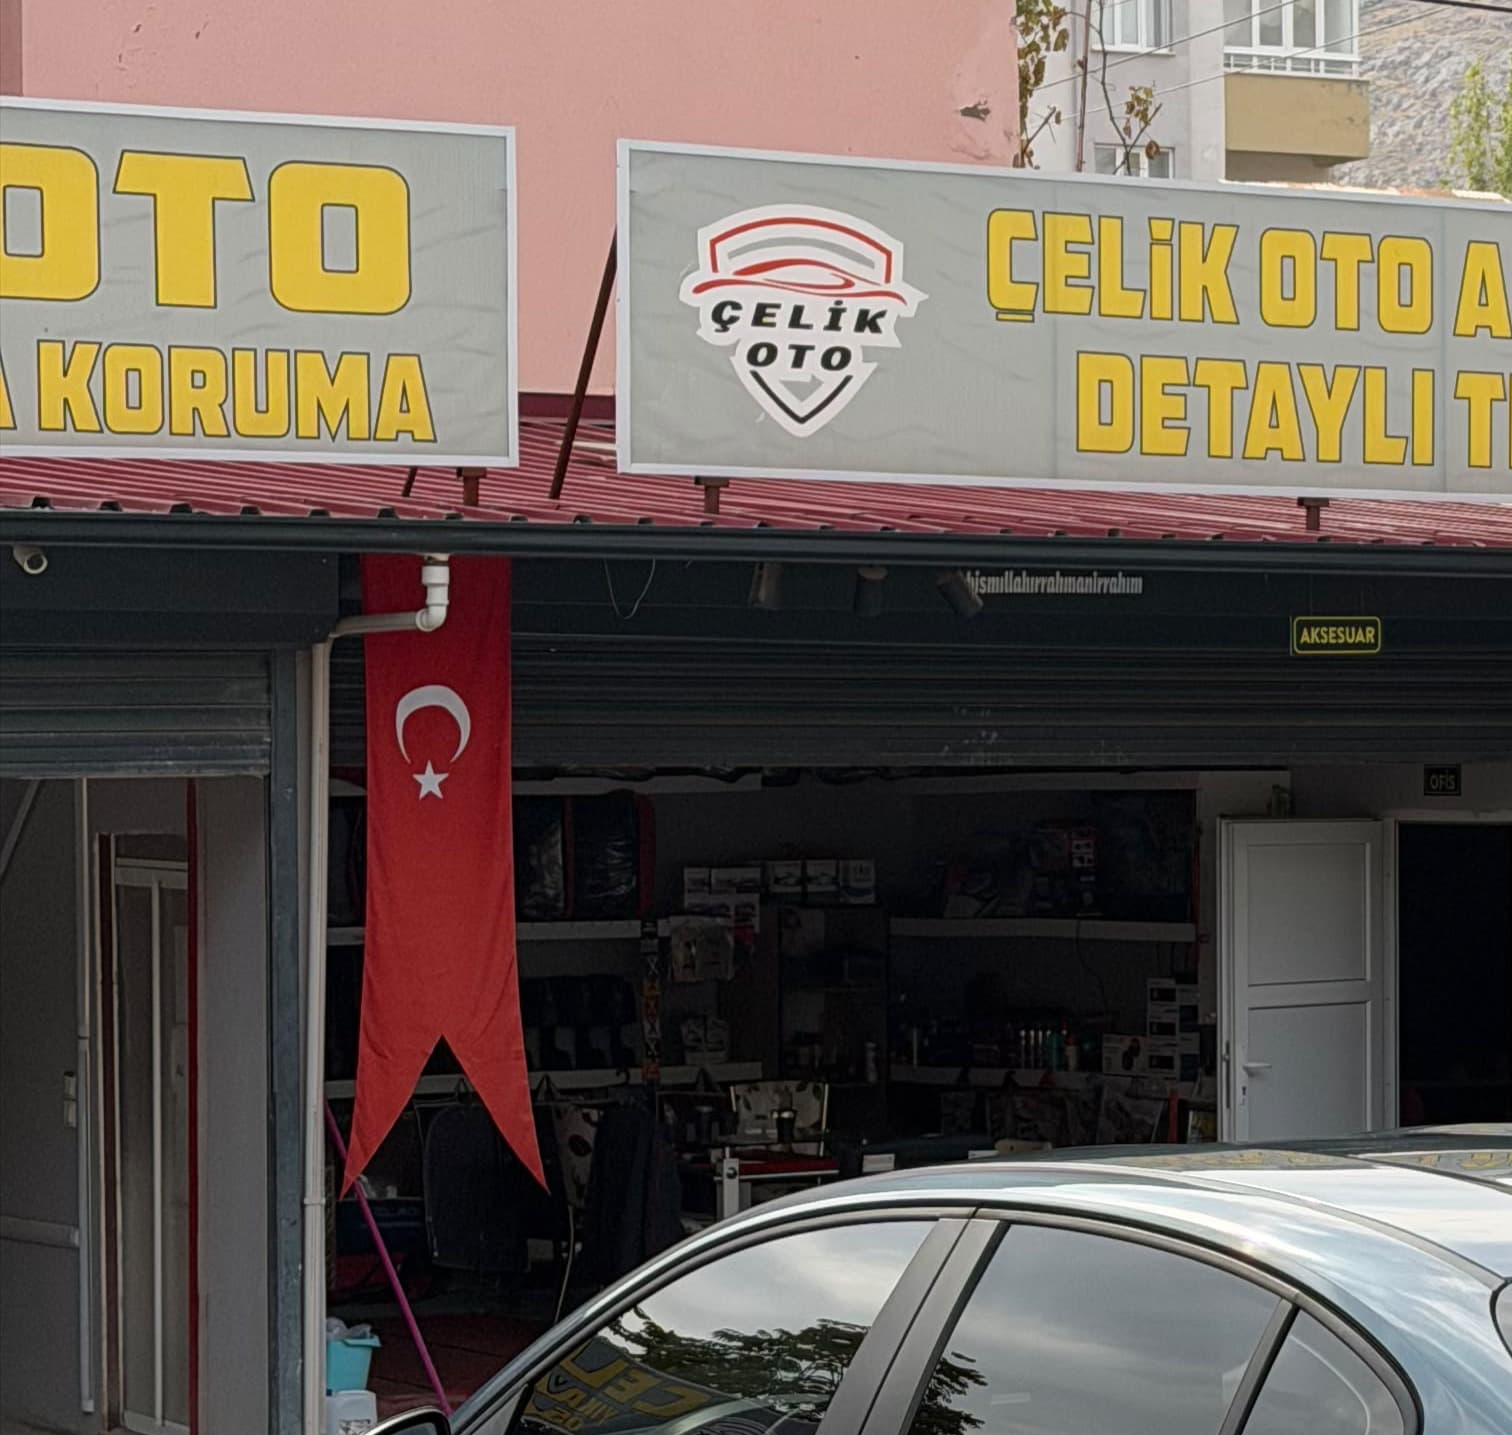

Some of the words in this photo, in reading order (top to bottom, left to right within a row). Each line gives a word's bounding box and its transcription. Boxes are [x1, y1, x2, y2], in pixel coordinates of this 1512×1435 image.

[0, 142, 412, 316] OTO
[986, 208, 1240, 324] ÇELİK
[1258, 227, 1433, 334] OTO
[710, 299, 888, 337] ÇELİK
[746, 342, 853, 371] OTO
[37, 339, 437, 443] KORUMA
[1076, 350, 1435, 467] DETAYLI
[1300, 626, 1376, 644] AKSESUAR
